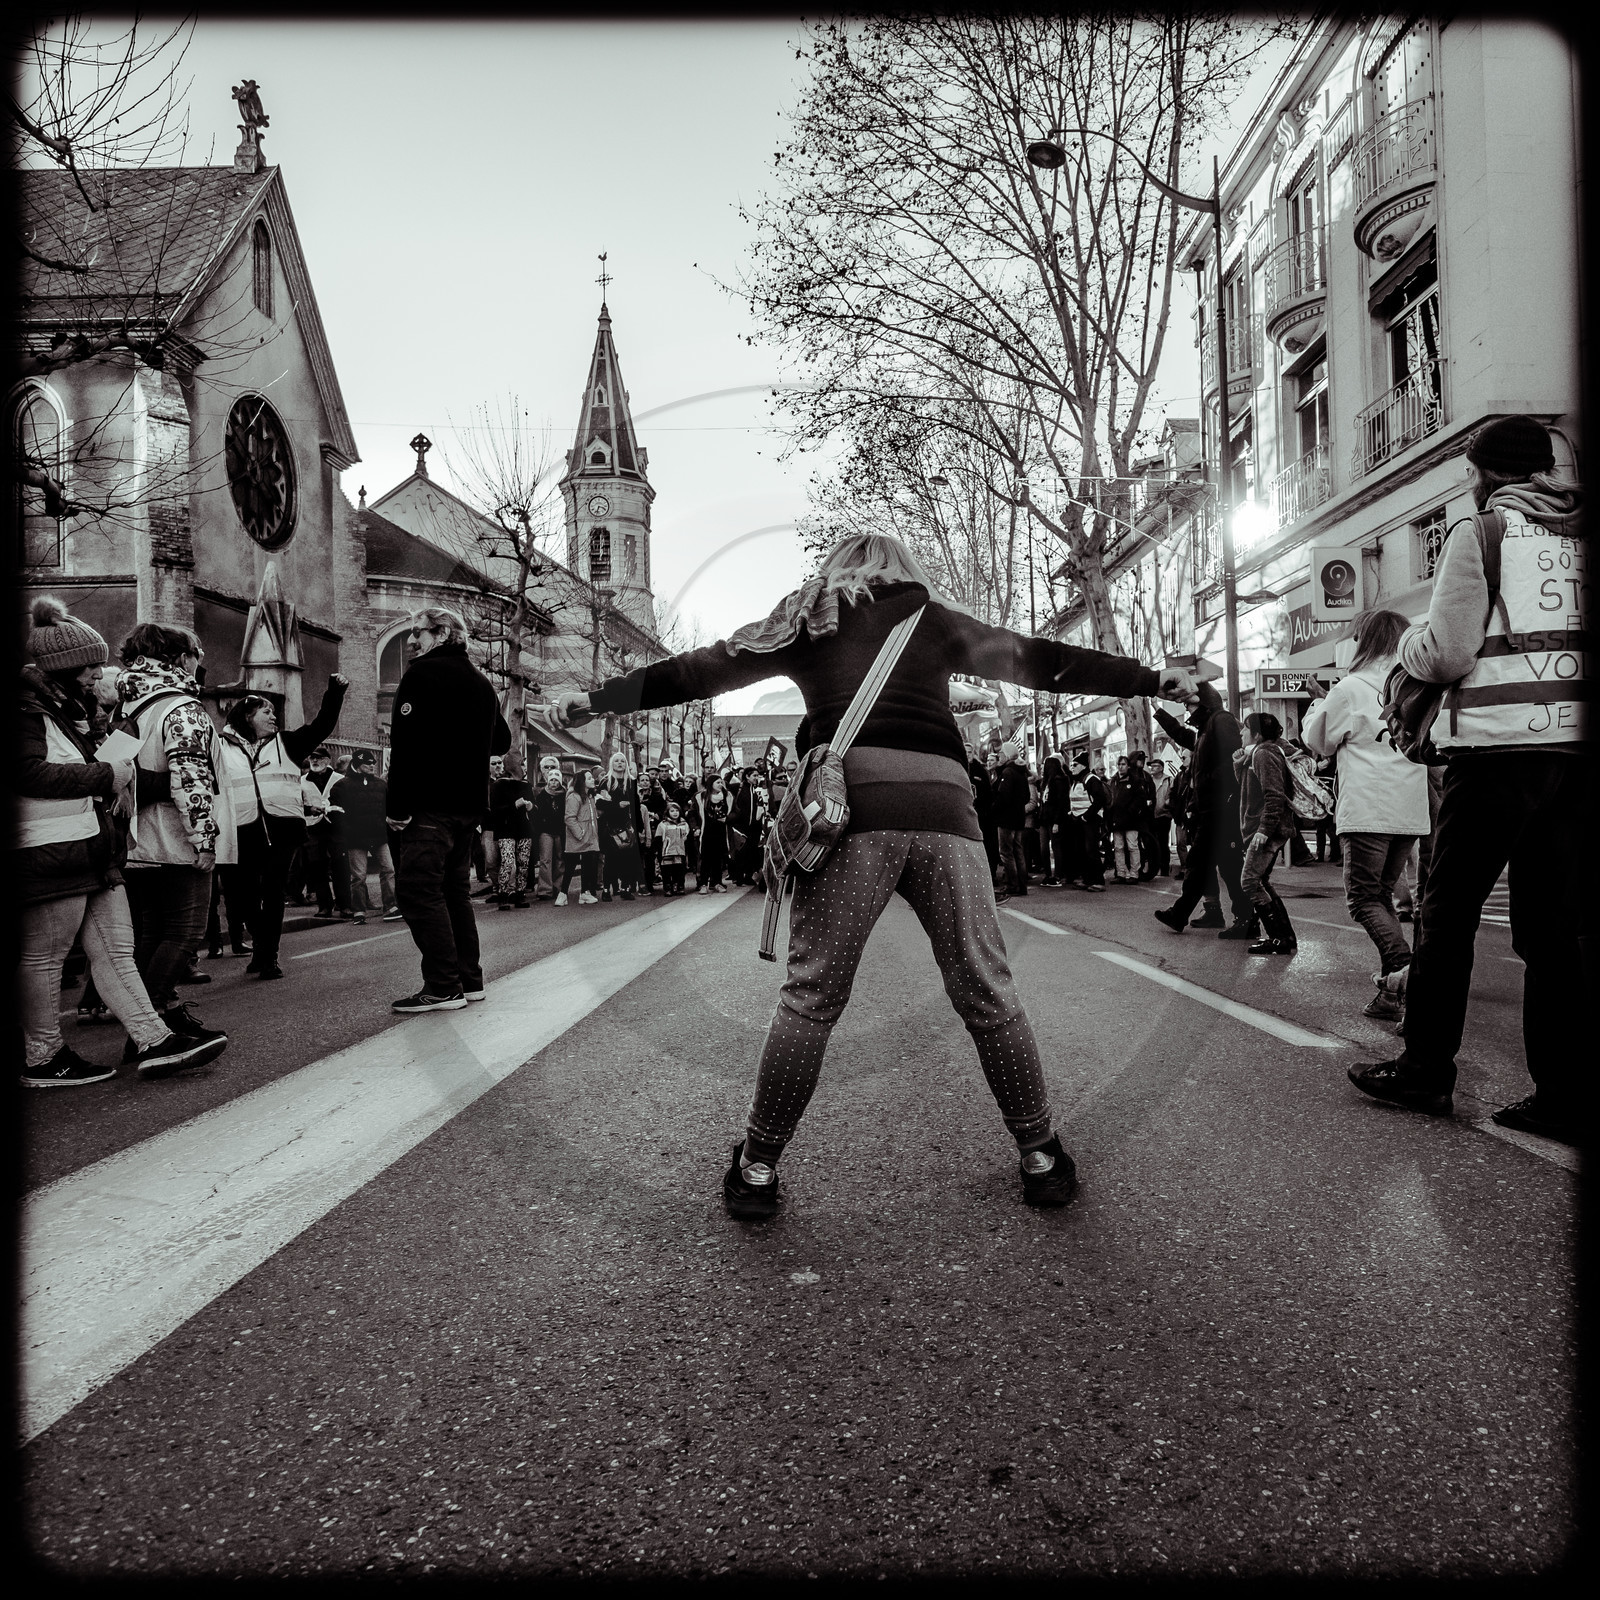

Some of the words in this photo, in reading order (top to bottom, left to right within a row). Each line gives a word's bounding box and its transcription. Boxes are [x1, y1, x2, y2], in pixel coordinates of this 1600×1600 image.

[1561, 538, 1580, 552] ET
[1327, 598, 1352, 606] Audika
[1282, 681, 1302, 692] 157
